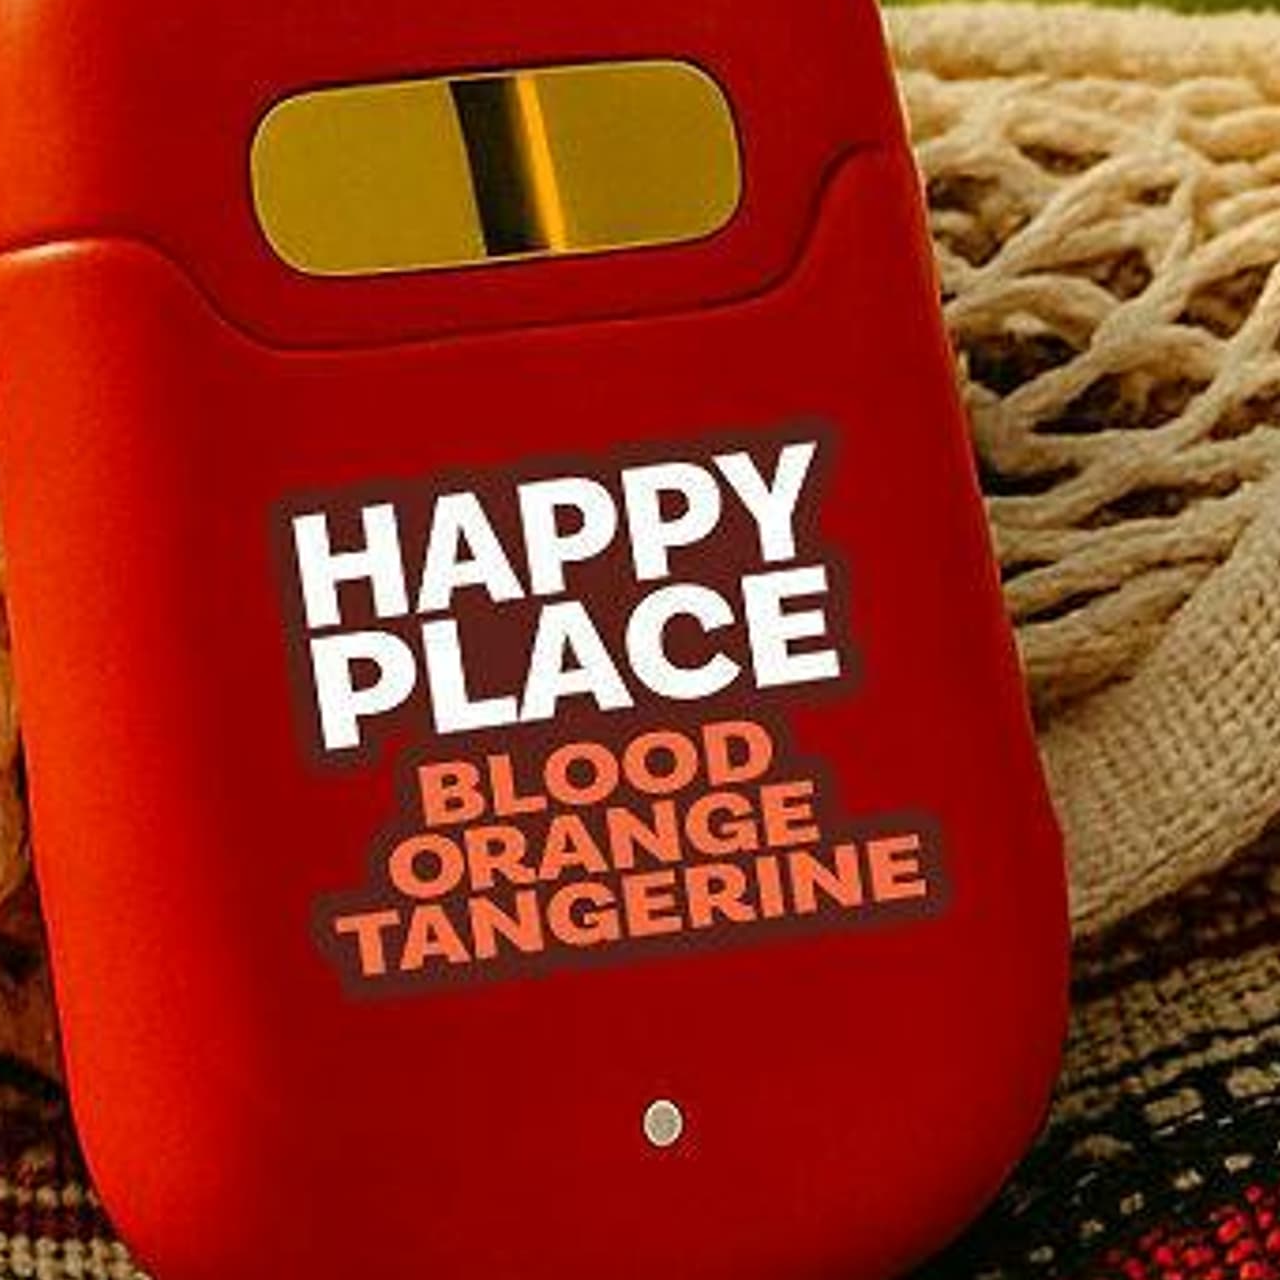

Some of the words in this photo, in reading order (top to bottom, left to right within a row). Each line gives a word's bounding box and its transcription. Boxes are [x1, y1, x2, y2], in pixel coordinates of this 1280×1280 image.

[293, 441, 818, 629] HAPPY
[309, 565, 841, 751] PLACE
[387, 780, 820, 899] ORANGE
[418, 719, 775, 828] BLOOD
[335, 833, 927, 977] TANGERINE
